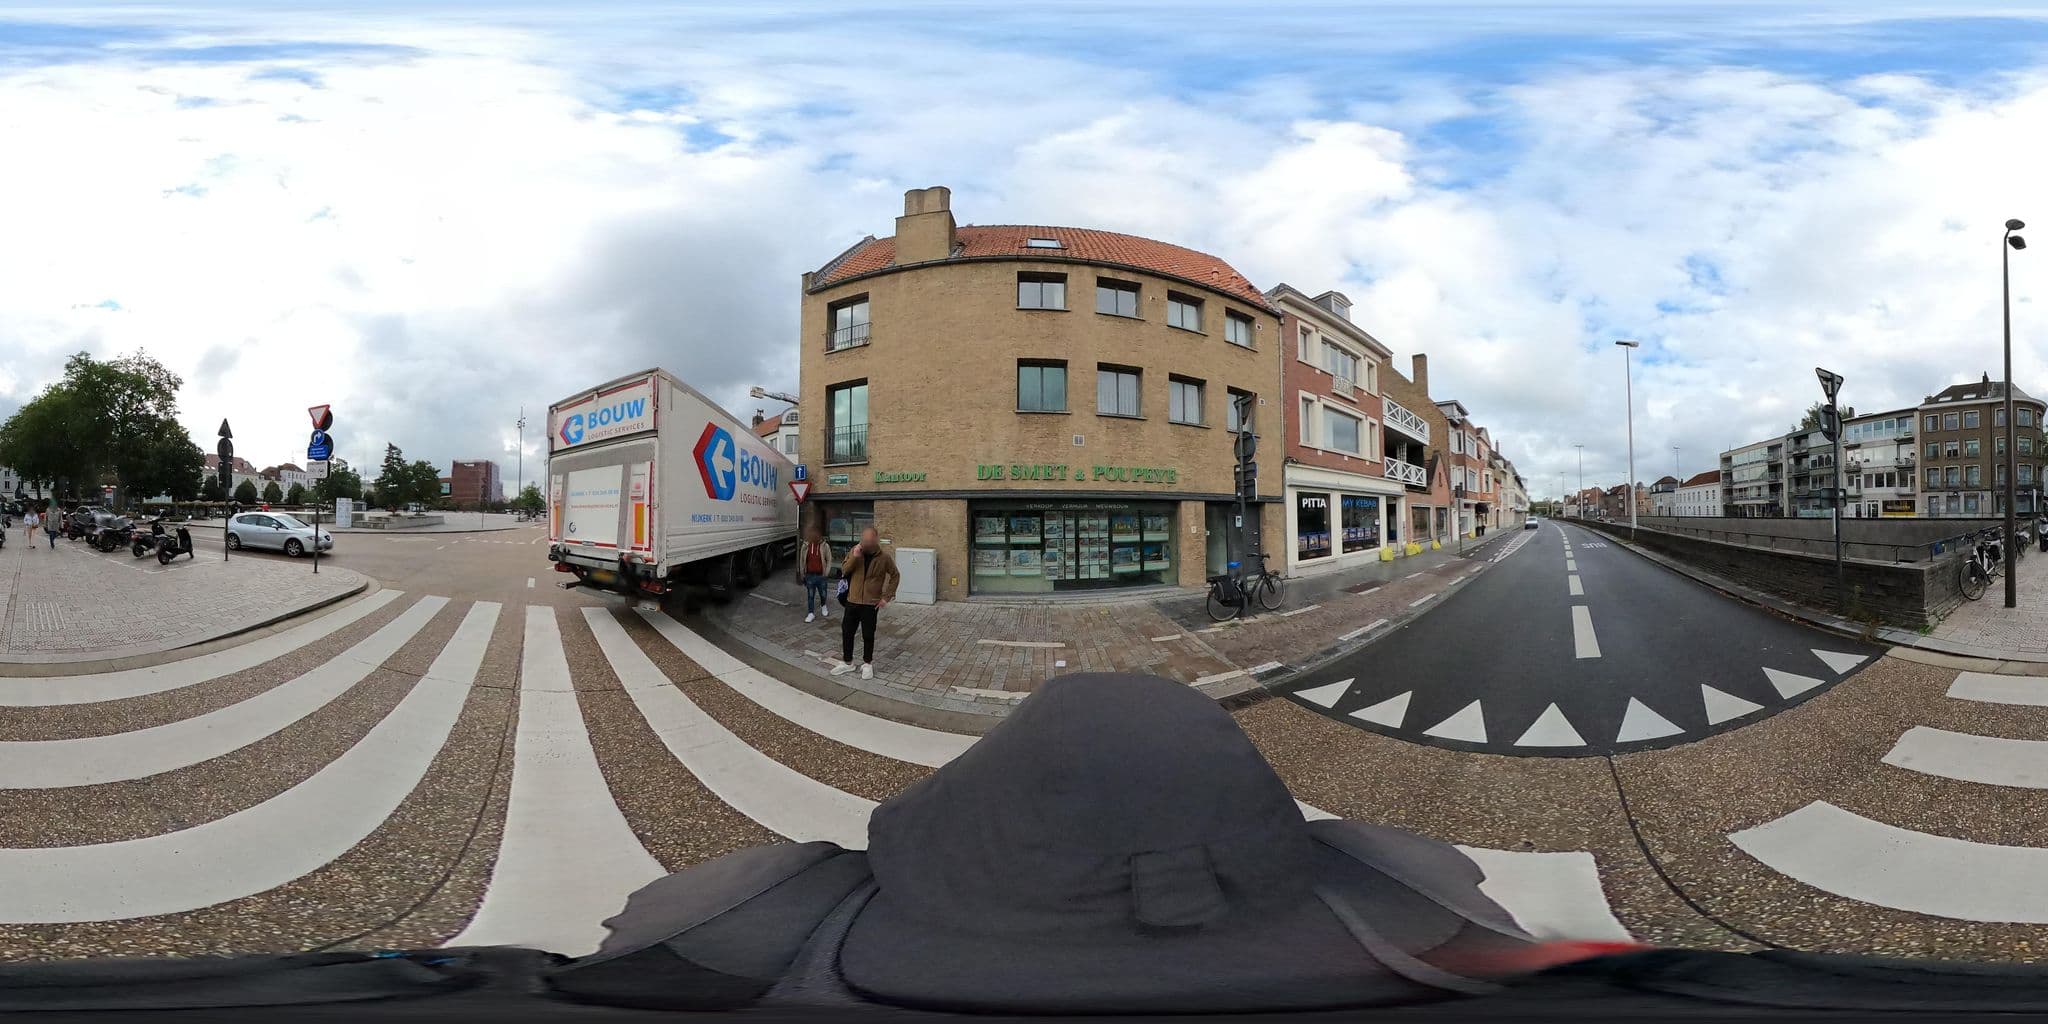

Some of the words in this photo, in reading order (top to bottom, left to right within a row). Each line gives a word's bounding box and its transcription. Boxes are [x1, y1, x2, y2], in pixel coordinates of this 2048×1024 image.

[588, 398, 645, 429] BOUW
[588, 429, 613, 440] LOGISTIC
[614, 422, 645, 434] SERVICES
[741, 448, 778, 493] BOUW
[874, 470, 927, 483] Kantoor
[977, 464, 1005, 481] DE
[1010, 464, 1068, 481] SMET
[1074, 468, 1086, 481] &
[1092, 464, 1177, 484] POUPEYE
[1302, 497, 1327, 509] PITTA
[1343, 498, 1354, 508] MY
[1355, 498, 1377, 508] KEBAB
